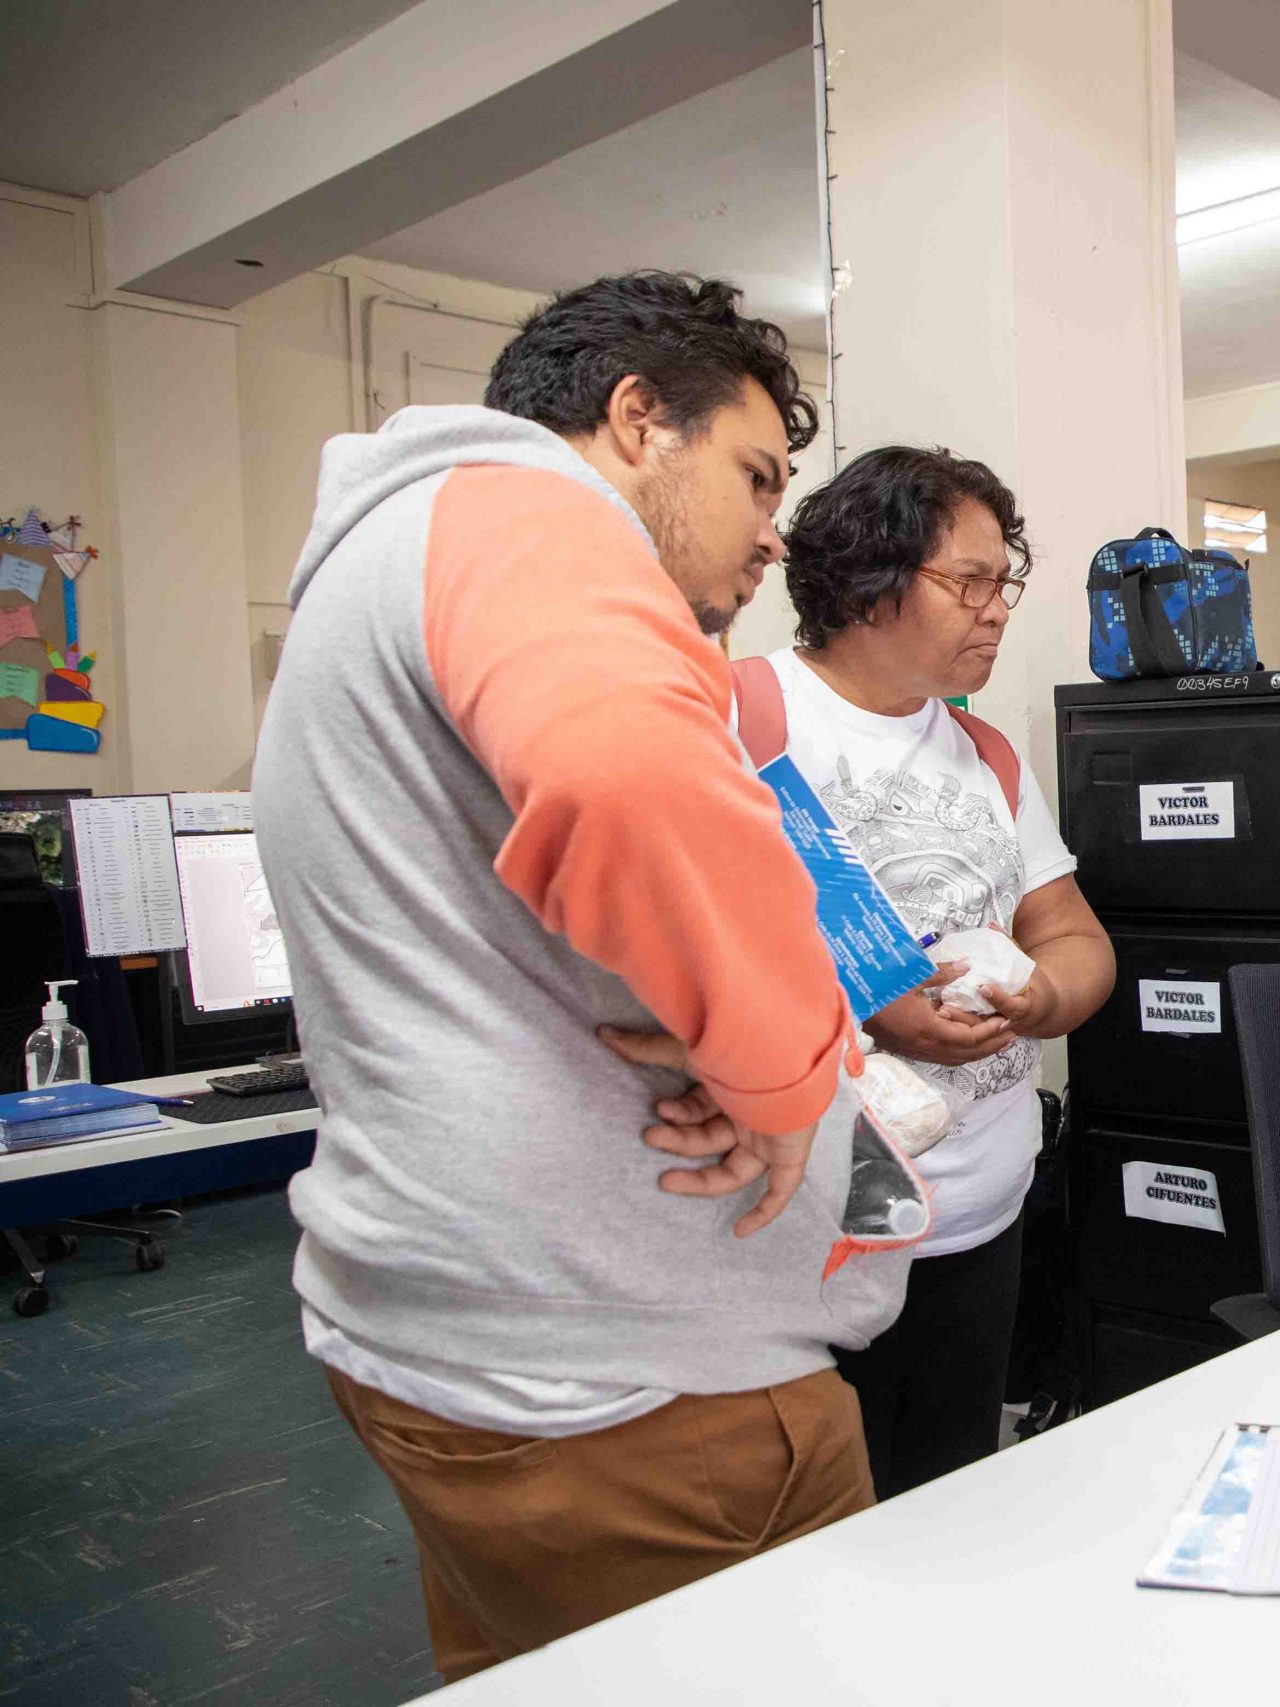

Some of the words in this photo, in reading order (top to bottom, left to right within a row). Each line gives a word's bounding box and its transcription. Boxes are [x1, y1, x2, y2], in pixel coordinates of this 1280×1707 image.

[1158, 796, 1209, 809] VICTOR
[1149, 813, 1220, 827] BARDALES
[1154, 990, 1204, 1005] VICTOR
[1146, 1006, 1216, 1023] BARDALES
[1154, 1171, 1208, 1191] ARTURO
[1146, 1186, 1217, 1209] CIFUENTES
